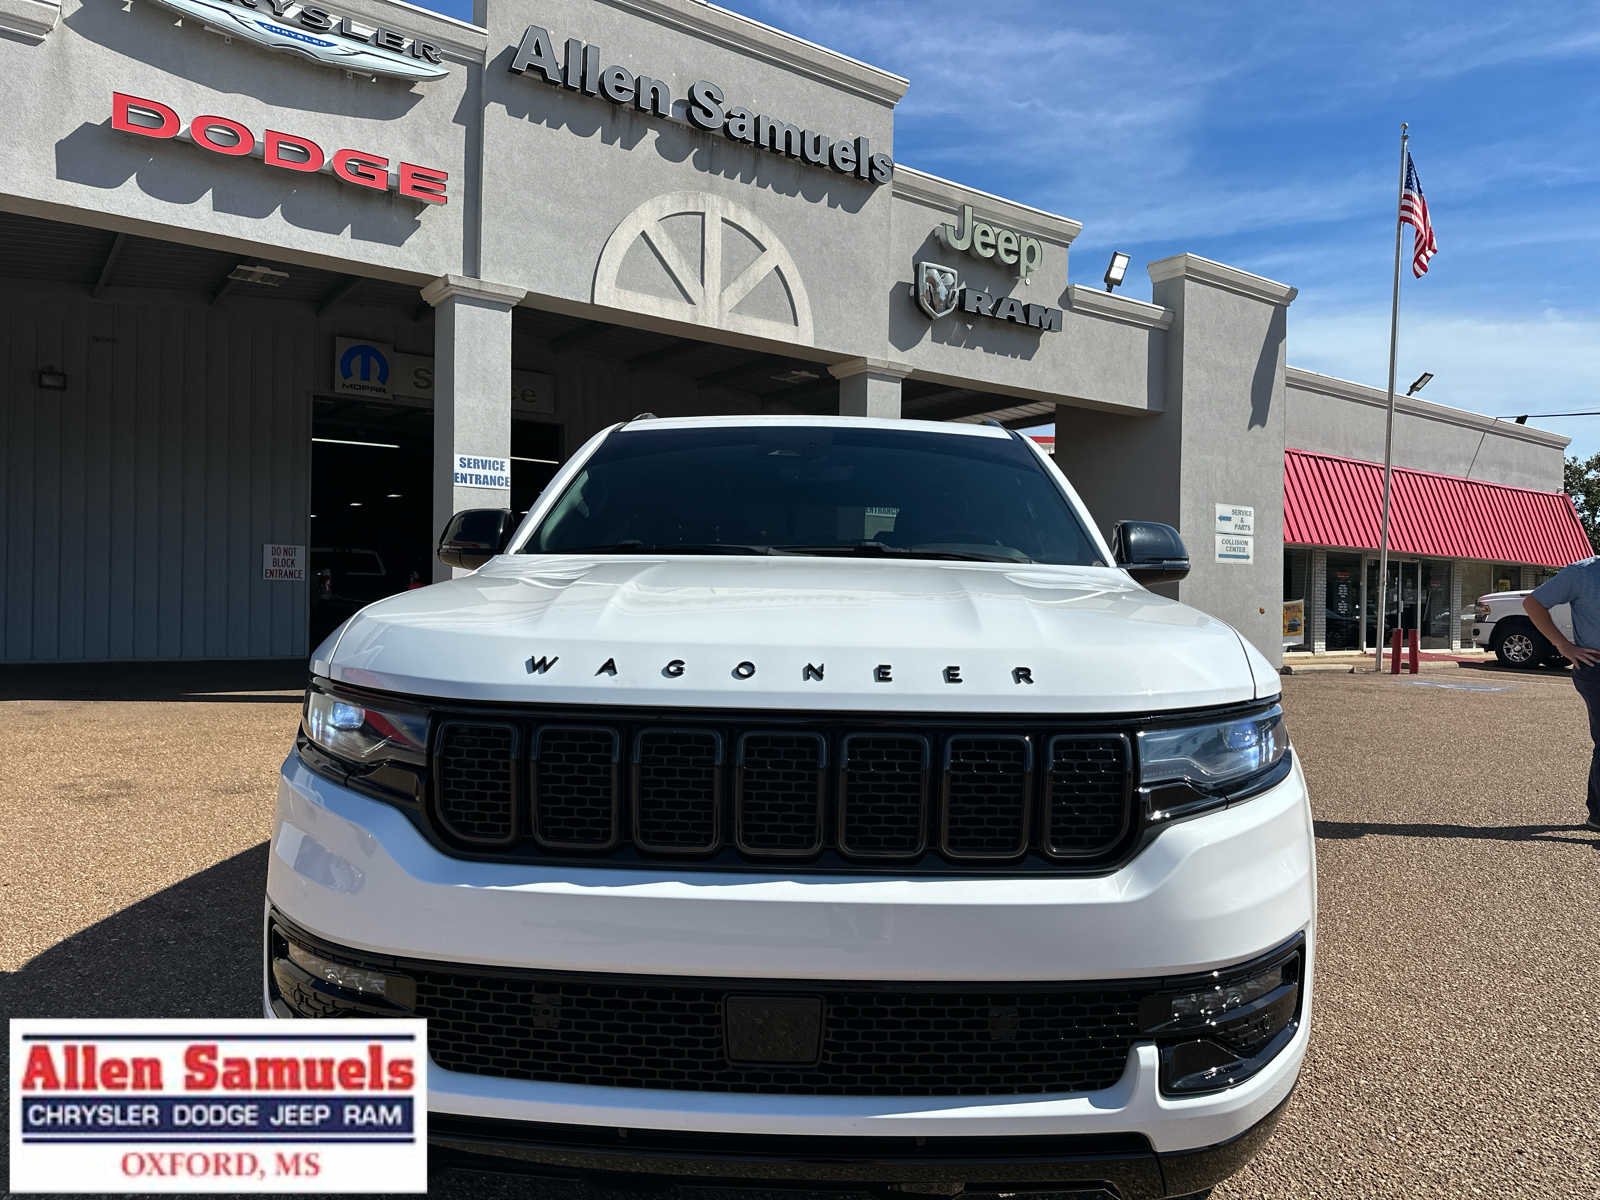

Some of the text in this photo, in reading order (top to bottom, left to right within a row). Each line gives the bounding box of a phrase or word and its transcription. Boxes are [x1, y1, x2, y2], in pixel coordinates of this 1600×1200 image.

[240, 0, 442, 64] YSLER
[262, 23, 329, 48] CHRYSLER
[511, 25, 893, 185] Allen Samuels
[111, 91, 448, 205] DODGE
[944, 204, 1042, 279] Jeep
[959, 287, 1063, 332] RAM
[458, 456, 506, 472] SERVICE
[454, 472, 510, 487] ENTRANCE
[1232, 508, 1252, 517] SERVICE
[1221, 538, 1249, 547] COLLISION
[1225, 545, 1246, 553] CENTER
[271, 546, 297, 557] DO NOT
[272, 557, 296, 568] BLOCK
[264, 568, 304, 579] ENTRANCE
[525, 655, 1035, 685] WAGONEER
